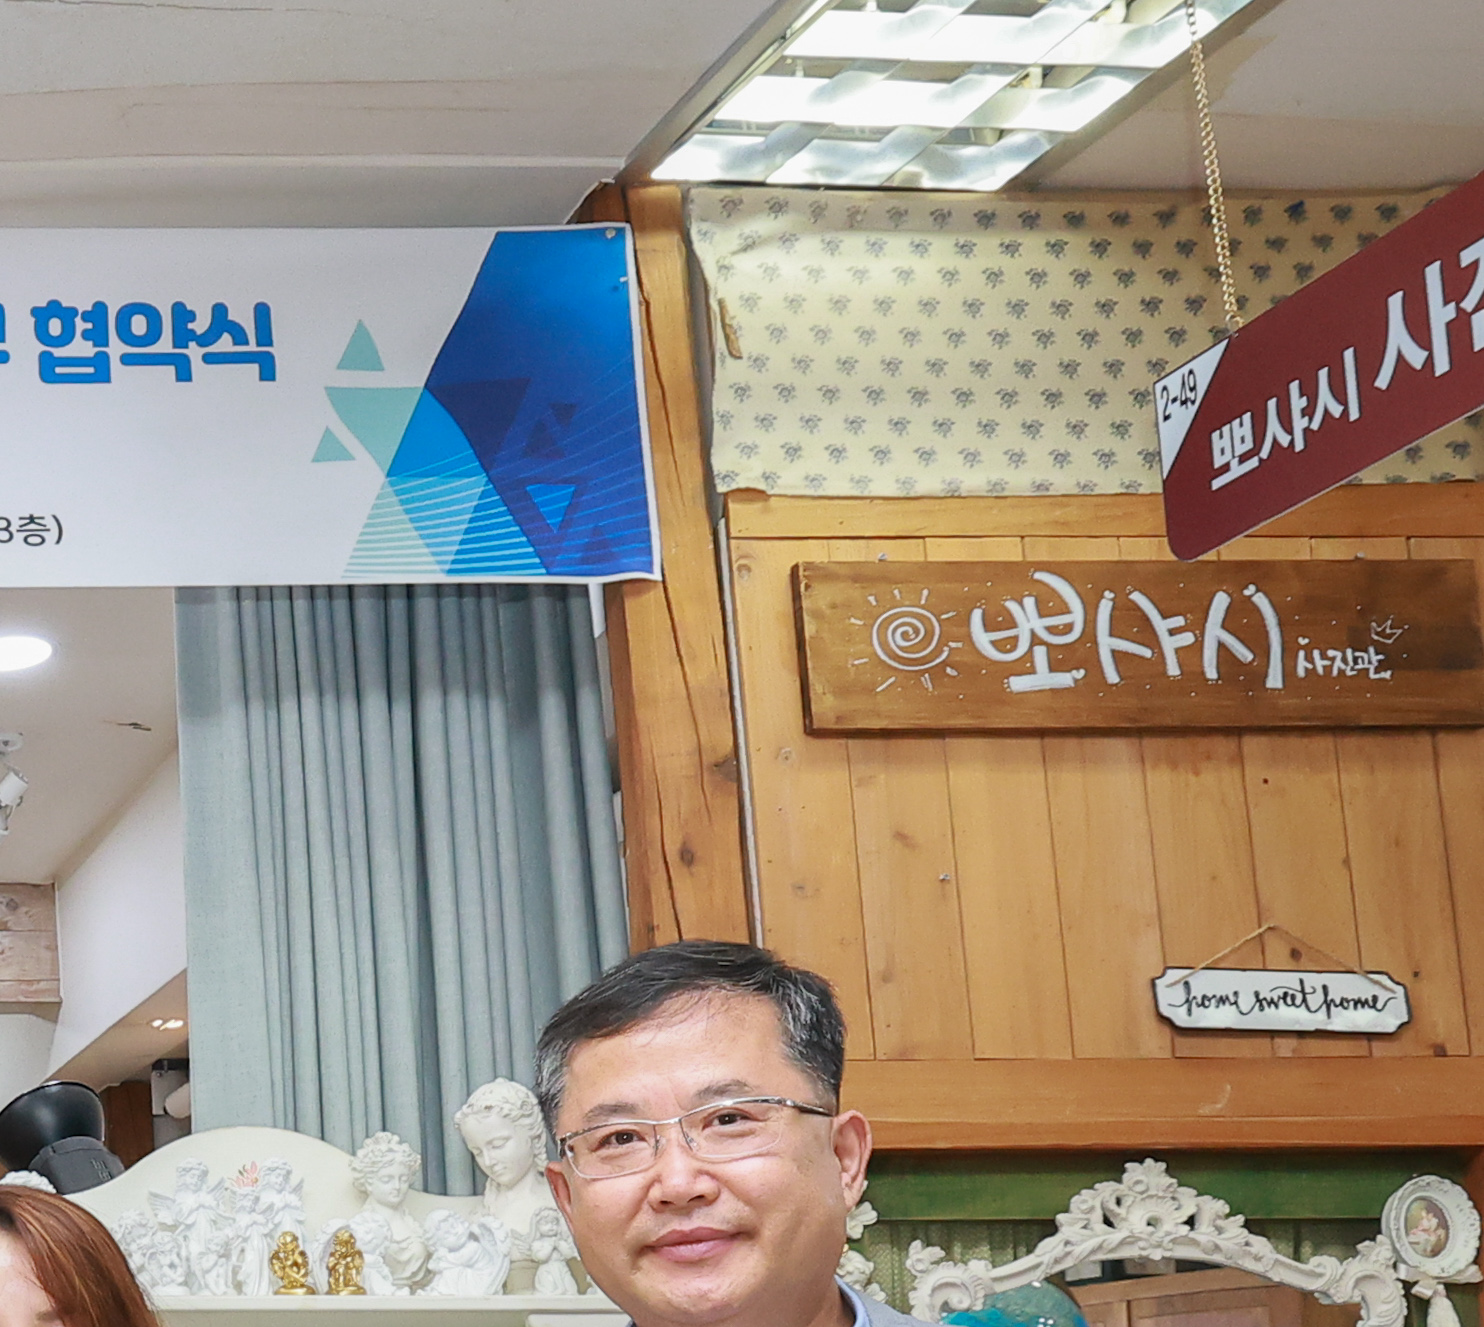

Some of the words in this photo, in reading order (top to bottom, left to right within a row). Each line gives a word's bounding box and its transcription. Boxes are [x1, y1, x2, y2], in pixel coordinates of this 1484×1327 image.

[31, 299, 277, 385] 협약식
[1160, 368, 1198, 423] 2-49
[1210, 347, 1362, 491] 뽀샤시
[969, 570, 1284, 691] 뽀샤시
[1295, 642, 1393, 680] 사진관
[1168, 980, 1242, 1017] home
[1252, 978, 1318, 1014] sweet
[1320, 984, 1398, 1019] home
